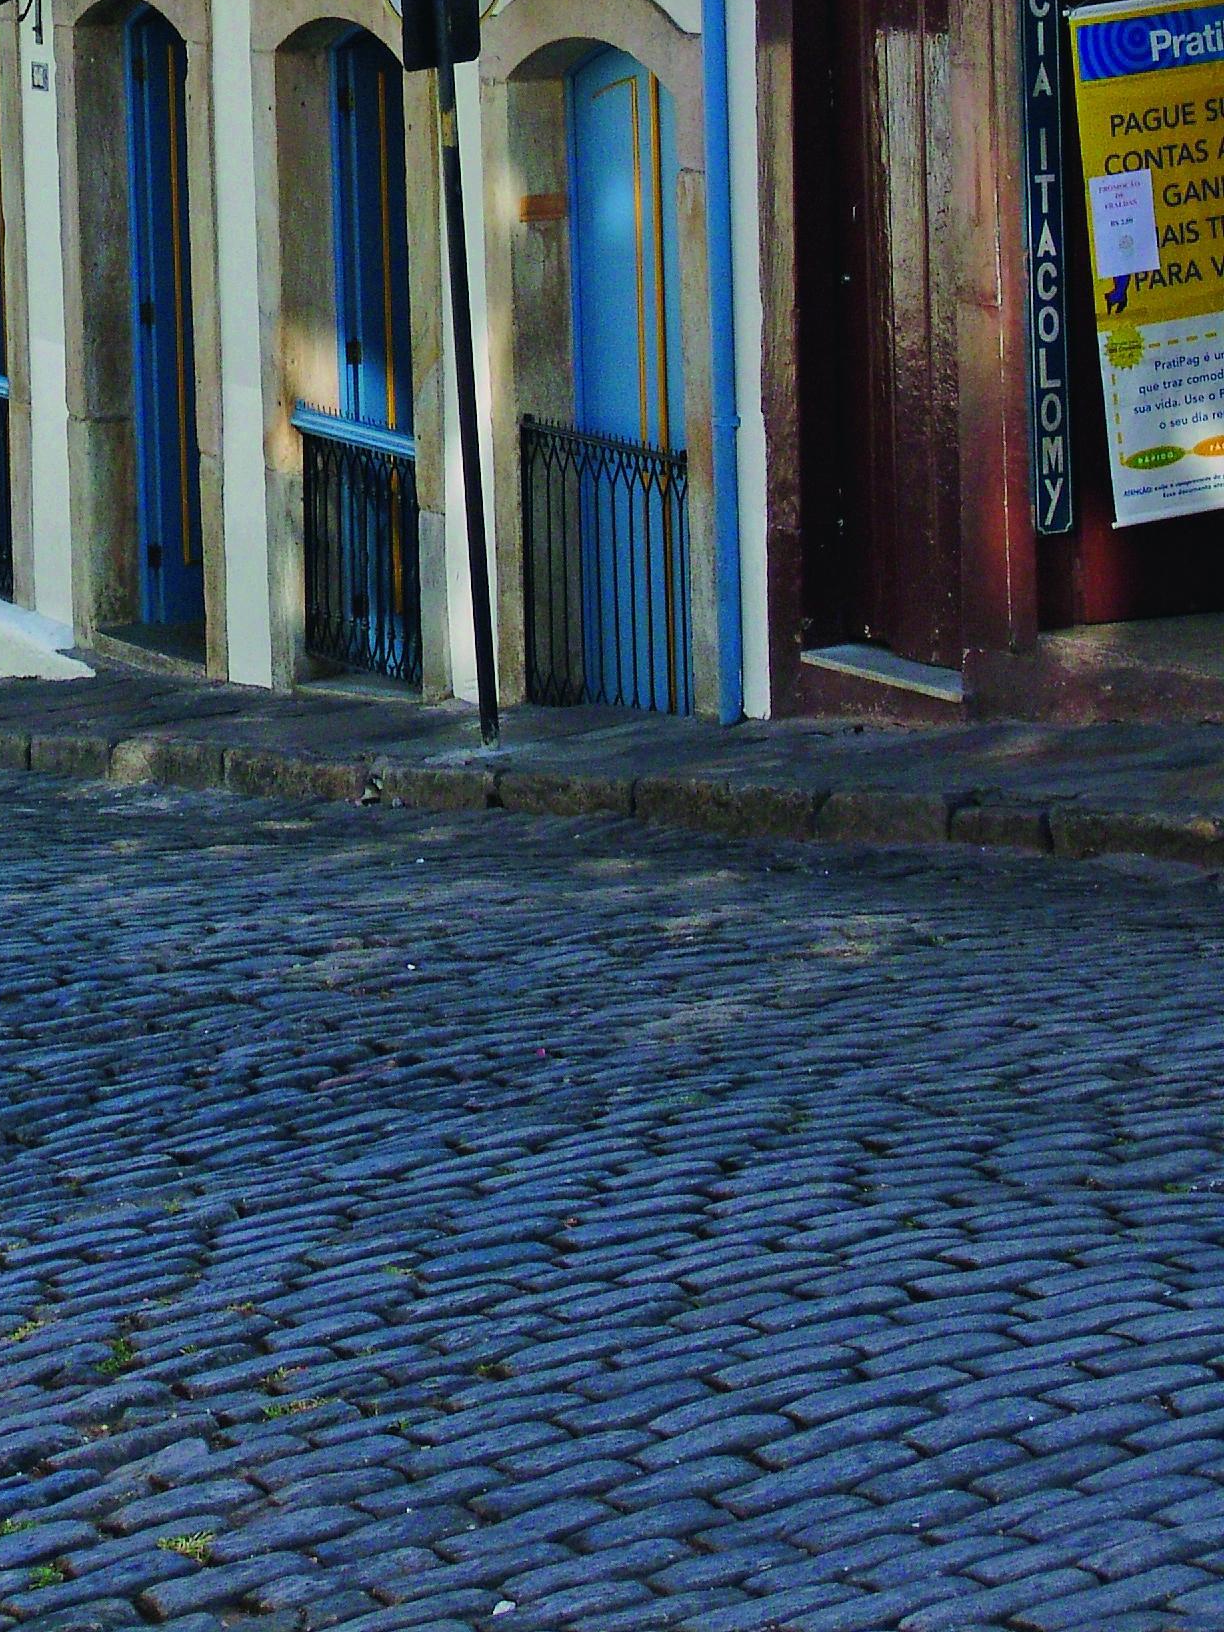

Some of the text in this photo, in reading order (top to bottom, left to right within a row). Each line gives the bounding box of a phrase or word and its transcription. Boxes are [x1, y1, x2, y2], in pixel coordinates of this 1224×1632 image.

[1149, 20, 1224, 63] Prati
[1110, 100, 1196, 138] PAGUE
[1104, 138, 1209, 176] CONTAS
[1205, 214, 1224, 240] T
[1134, 259, 1203, 292] PARA
[1033, 127, 1064, 526] ITACOLOMY
[1154, 355, 1200, 371] PratiPag
[1138, 382, 1160, 396] que
[1162, 378, 1183, 391] traz
[1133, 404, 1152, 415] sua
[1154, 397, 1181, 411] vida.
[1184, 393, 1205, 405] Use
[1208, 393, 1216, 401] o
[1159, 421, 1167, 430] o
[1169, 417, 1188, 428] seu
[1191, 411, 1209, 424] dia
